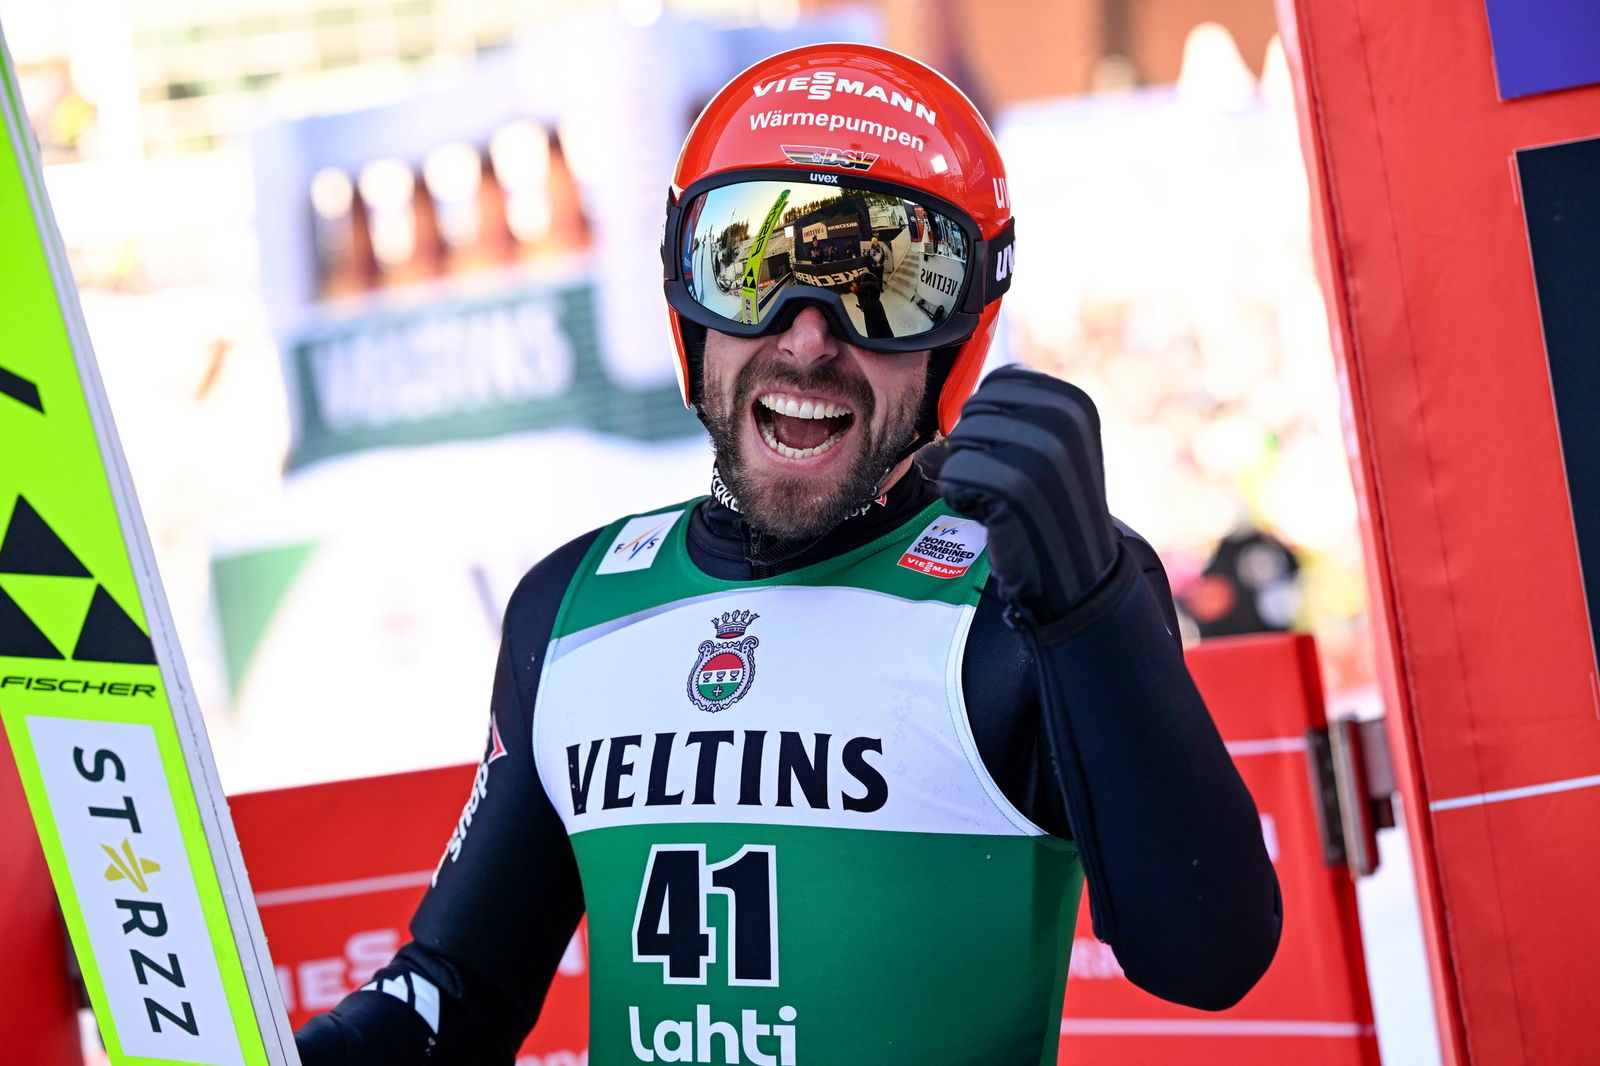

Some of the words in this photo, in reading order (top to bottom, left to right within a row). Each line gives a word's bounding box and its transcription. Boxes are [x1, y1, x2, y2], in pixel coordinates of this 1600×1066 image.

[753, 71, 937, 126] VIESSMANN
[750, 110, 924, 152] Wärmepumpen
[809, 173, 838, 183] uvex
[613, 537, 660, 554] FIS
[917, 541, 975, 559] COMBINED
[921, 536, 966, 551] NORDIC
[913, 546, 945, 560] WORLD
[945, 555, 964, 564] CUP
[907, 557, 963, 574] VIESSMANN
[1, 676, 156, 698] FISCHER
[566, 730, 889, 816] VELTINS
[632, 843, 779, 987] 41
